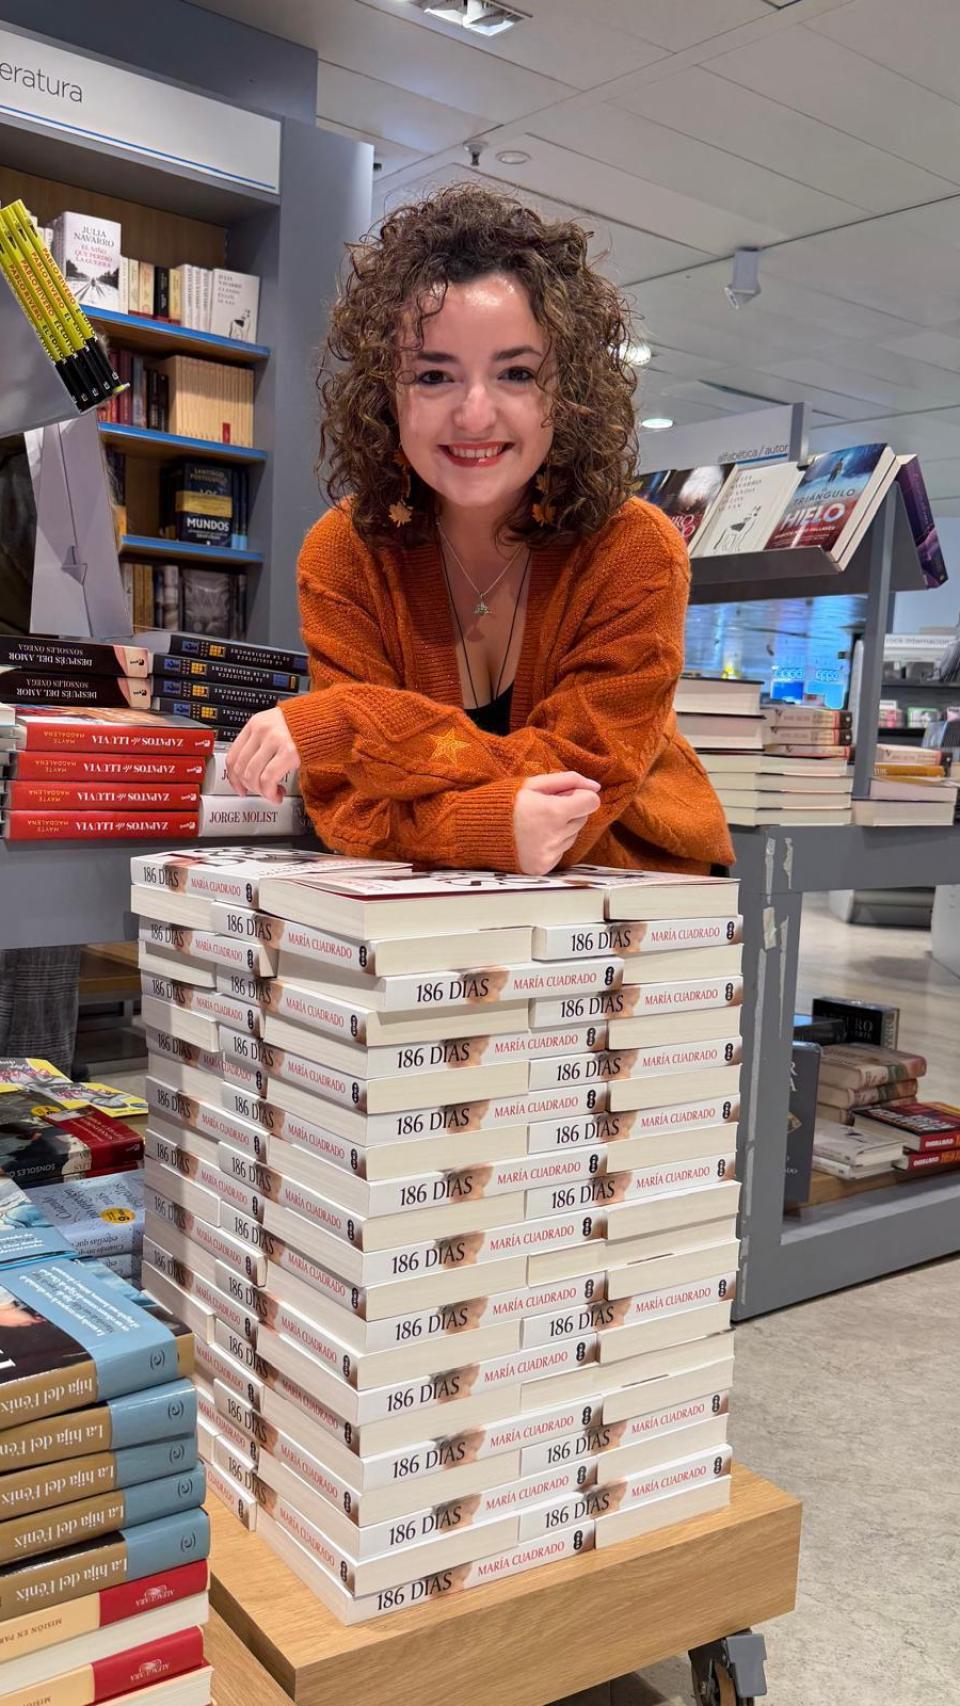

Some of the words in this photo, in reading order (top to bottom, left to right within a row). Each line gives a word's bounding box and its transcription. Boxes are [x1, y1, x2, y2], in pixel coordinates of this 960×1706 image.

[765, 444, 788, 455] autor
[780, 502, 845, 530] HIELO
[186, 517, 230, 532] MUNDOS
[8, 652, 34, 662] AMOR
[36, 655, 52, 664] DEL
[16, 688, 42, 696] AMOR
[44, 689, 59, 698] DEL
[91, 735, 129, 745] LLUVIA
[142, 737, 184, 747] ZAPATOS
[83, 763, 121, 774] LLUVIA
[134, 764, 175, 774] ZAPATOS
[210, 812, 240, 824] JORGE
[242, 811, 278, 822] MOLIST
[75, 821, 113, 832] LLUVIA
[127, 821, 168, 831] ZAPATOS
[143, 866, 156, 882] 186
[191, 877, 208, 892] MARÍA
[210, 880, 241, 897] CUADRADO
[227, 914, 244, 934] 186
[288, 932, 310, 949] MARÍA
[312, 939, 352, 960] CUADRADO
[572, 933, 594, 951] 186
[651, 928, 676, 942] MARÍA
[679, 927, 720, 940] CUADRADO
[417, 982, 443, 1002] 186
[513, 973, 544, 990] MARÍA
[546, 972, 597, 987] CUADRADO
[230, 976, 246, 993] 186
[286, 997, 306, 1014] MARÍA
[308, 1005, 344, 1028] CUADRADO
[561, 1000, 584, 1017] 186
[645, 990, 672, 1006] MARÍA
[674, 989, 718, 1003] CUADRADO
[397, 1049, 424, 1069] 186
[495, 1037, 525, 1053] MARÍA
[528, 1034, 578, 1049] CUADRADO
[397, 1114, 424, 1135] 186
[494, 1102, 525, 1118] MARÍA
[528, 1096, 578, 1113] CUADRADO
[556, 1124, 579, 1144] 186
[641, 1113, 668, 1127] MARÍA
[670, 1108, 716, 1124] CUADRADO
[16, 1163, 56, 1176] SONSOLES
[400, 1184, 427, 1206] 186
[498, 1168, 528, 1185] MARÍA
[530, 1162, 580, 1179] CUADRADO
[552, 1188, 575, 1209] 186
[636, 1174, 664, 1189] MARÍA
[665, 1166, 710, 1184] CUADRADO
[392, 1252, 419, 1274] 186
[490, 1233, 520, 1251] MARÍA
[523, 1225, 574, 1244] CUADRADO
[550, 1316, 574, 1337] 186
[635, 1297, 664, 1313] MARÍA
[665, 1287, 711, 1306] CUADRADO
[68, 1378, 92, 1394] hija
[387, 1388, 414, 1412] 186
[484, 1364, 515, 1383] MARÍA
[517, 1352, 568, 1373] CUADRADO
[43, 1386, 65, 1404] del
[56, 1428, 82, 1444] hija
[86, 1424, 103, 1438] La
[30, 1436, 53, 1452] del
[393, 1455, 420, 1478] 186
[490, 1428, 521, 1448] MARÍA
[523, 1416, 574, 1437] CUADRADO
[70, 1467, 95, 1484] hija
[98, 1465, 114, 1479] La
[46, 1475, 66, 1491] del
[2, 1481, 40, 1504] Fénix
[545, 1506, 569, 1528] 186
[631, 1481, 658, 1497] MARÍA
[660, 1466, 706, 1488] CUADRADO
[81, 1510, 105, 1526] hija
[109, 1505, 123, 1519] La
[389, 1521, 416, 1545] 186
[486, 1491, 516, 1510] MARÍA
[519, 1475, 569, 1499] CUADRADO
[57, 1518, 77, 1534] del
[14, 1526, 52, 1548] Fénix
[84, 1564, 108, 1580] hija
[112, 1557, 127, 1572] La
[60, 1572, 80, 1588] del
[376, 1588, 404, 1610] 186
[478, 1558, 509, 1576] MARÍA
[512, 1541, 564, 1566] CUADRADO
[16, 1580, 55, 1601] Fénix
[17, 1629, 28, 1640] EN
[31, 1618, 62, 1635] MISIÓN
